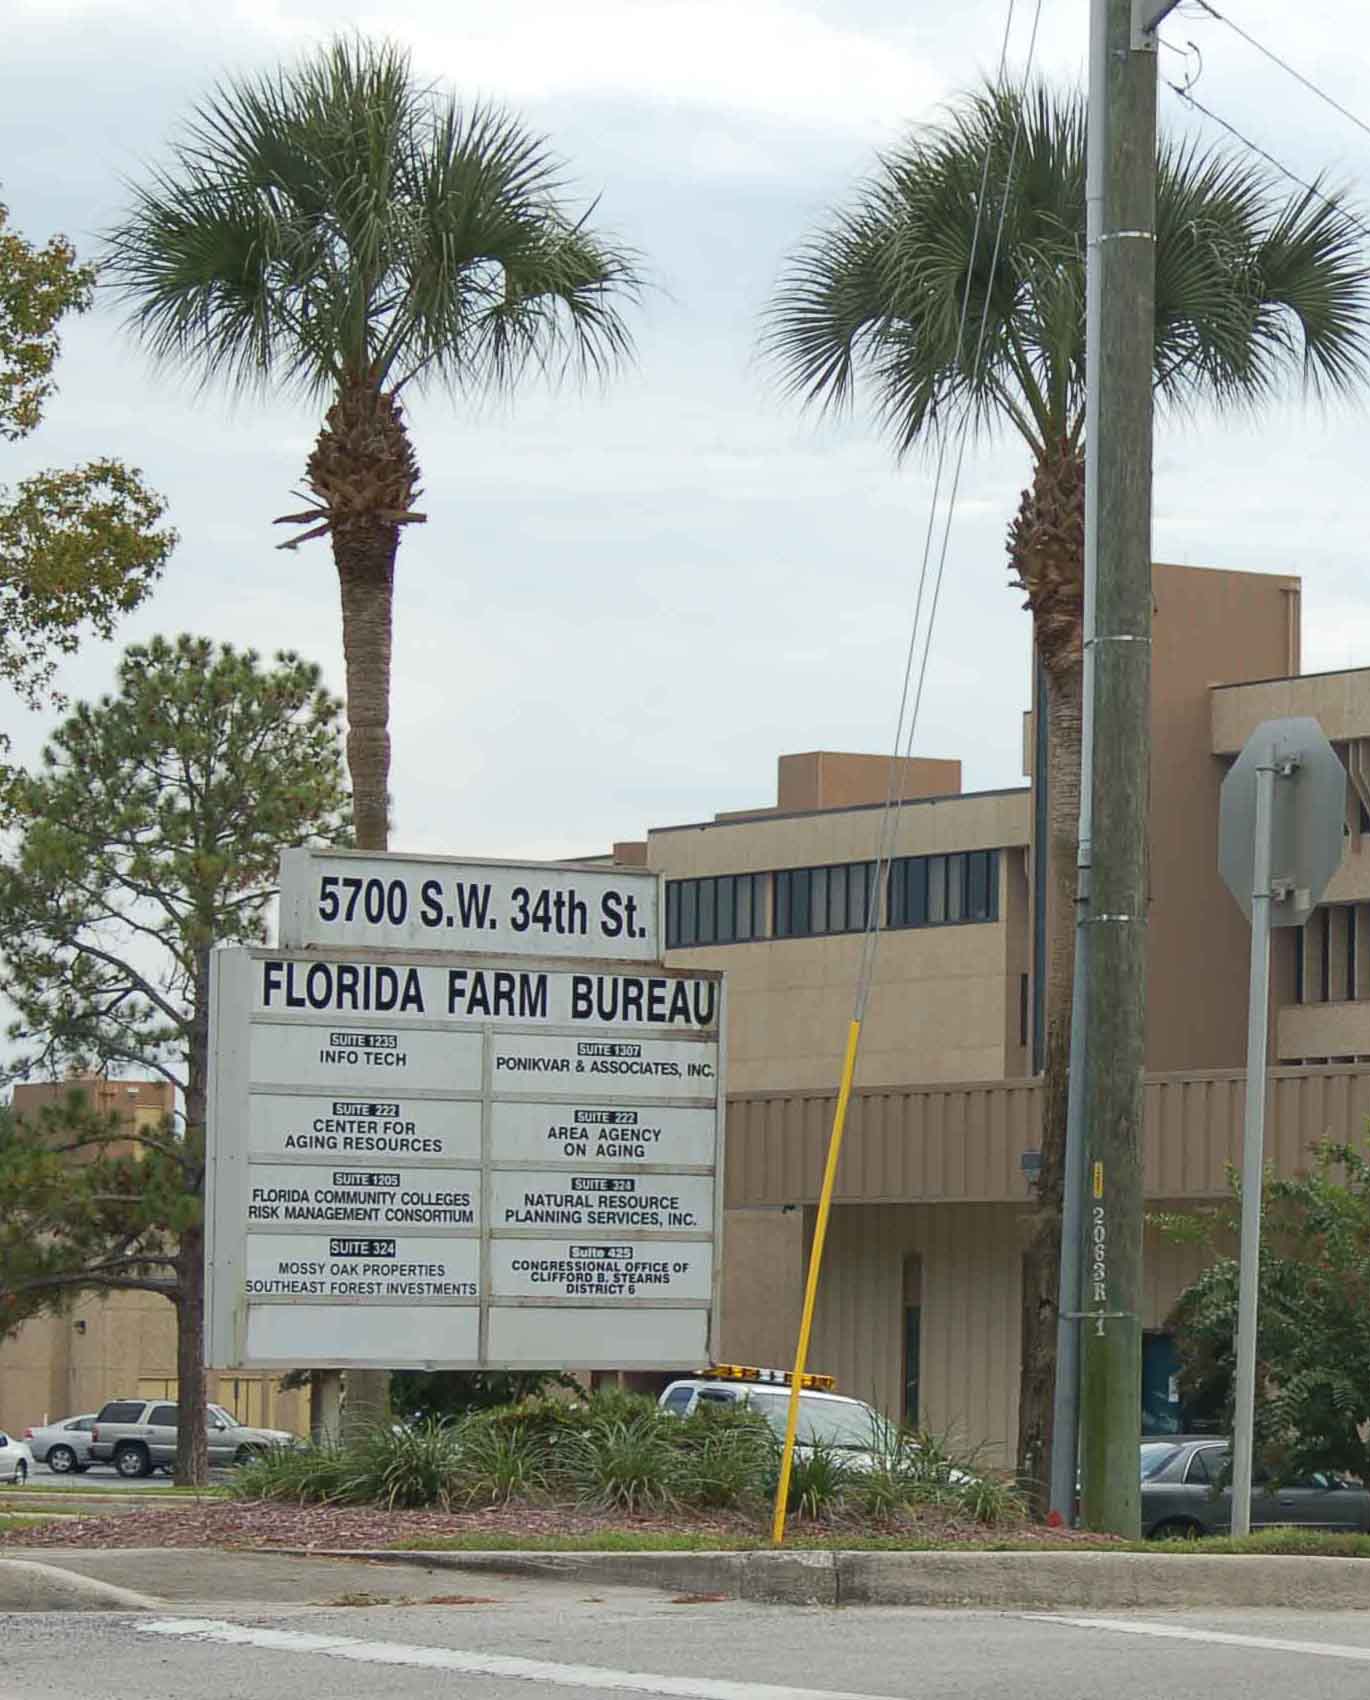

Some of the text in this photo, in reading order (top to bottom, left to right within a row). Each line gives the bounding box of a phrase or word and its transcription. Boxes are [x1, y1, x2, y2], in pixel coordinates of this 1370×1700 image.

[318, 876, 647, 938] 5700 S.W. 34th St.
[263, 960, 715, 1026] FLORIDA FARM BUREAU
[331, 1034, 397, 1048] SUITE 1235
[579, 1043, 611, 1056] SUITE
[320, 1050, 407, 1067] INFO TECH
[496, 1057, 715, 1078] PONIKVAR & ASSOCIATES, INC.
[335, 1104, 397, 1117] SUITE 222
[577, 1112, 636, 1124] SUITE 222
[313, 1119, 416, 1135] CENTER FOR
[547, 1127, 662, 1142] AREA AGENCY
[285, 1135, 442, 1152] AGING RESOURCES
[563, 1143, 645, 1158] ON AGING
[334, 1173, 399, 1186] SUITE 1205
[574, 1178, 608, 1190] SUITE
[252, 1189, 470, 1207] FLORIDA COMMUNITY COLLEGES
[524, 1193, 679, 1210] NATURAL RESOURCE
[248, 1205, 474, 1223] RISK MANAGEMENT CONSORTIUM
[505, 1209, 697, 1227] PLANNING SERVICES, INC.
[331, 1240, 395, 1256] SUITE 324
[571, 1247, 605, 1259] Suite
[278, 1262, 445, 1277] MOSSY OAK PROPERTIES
[511, 1260, 689, 1273] CONGRESSIONAL OFFICE OF
[531, 1272, 592, 1283] CLIFFORD
[614, 1273, 670, 1284] STEARNS
[245, 1280, 477, 1296] SOUTHEAST FOREST INVESTMENTS
[566, 1284, 636, 1295] DISTRICT 6
